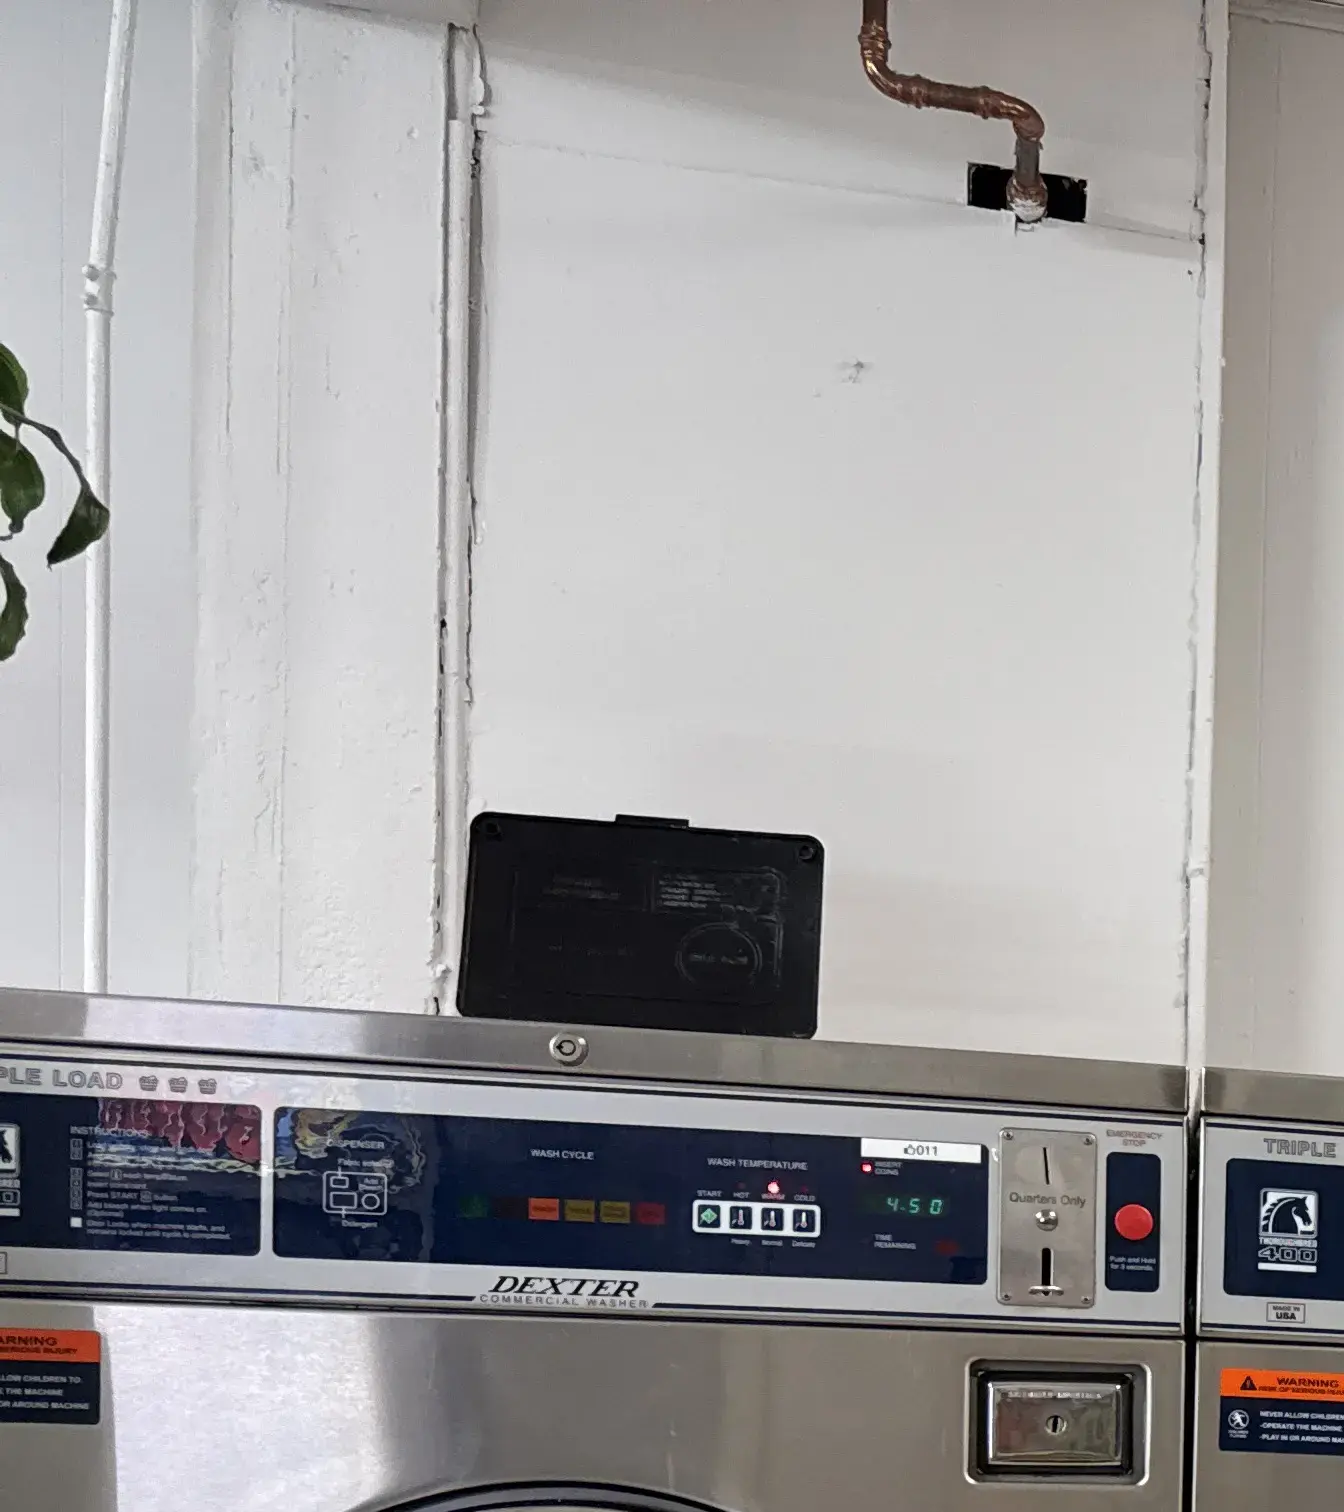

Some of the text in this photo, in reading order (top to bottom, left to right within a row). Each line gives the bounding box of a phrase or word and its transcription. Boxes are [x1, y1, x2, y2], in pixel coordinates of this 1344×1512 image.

[53, 1069, 123, 1090] LOAD
[531, 1149, 594, 1160] WASH CYCLE
[1263, 1138, 1336, 1158] TRIPLE
[708, 1157, 808, 1171] WASH TEMPERATURE
[1010, 1191, 1086, 1209] Quarters Only
[1258, 1246, 1317, 1263] 400
[488, 1276, 639, 1297] DEXTER
[479, 1294, 649, 1308] COMMERCIAL WASHER
[1277, 1377, 1339, 1387] WARNING
